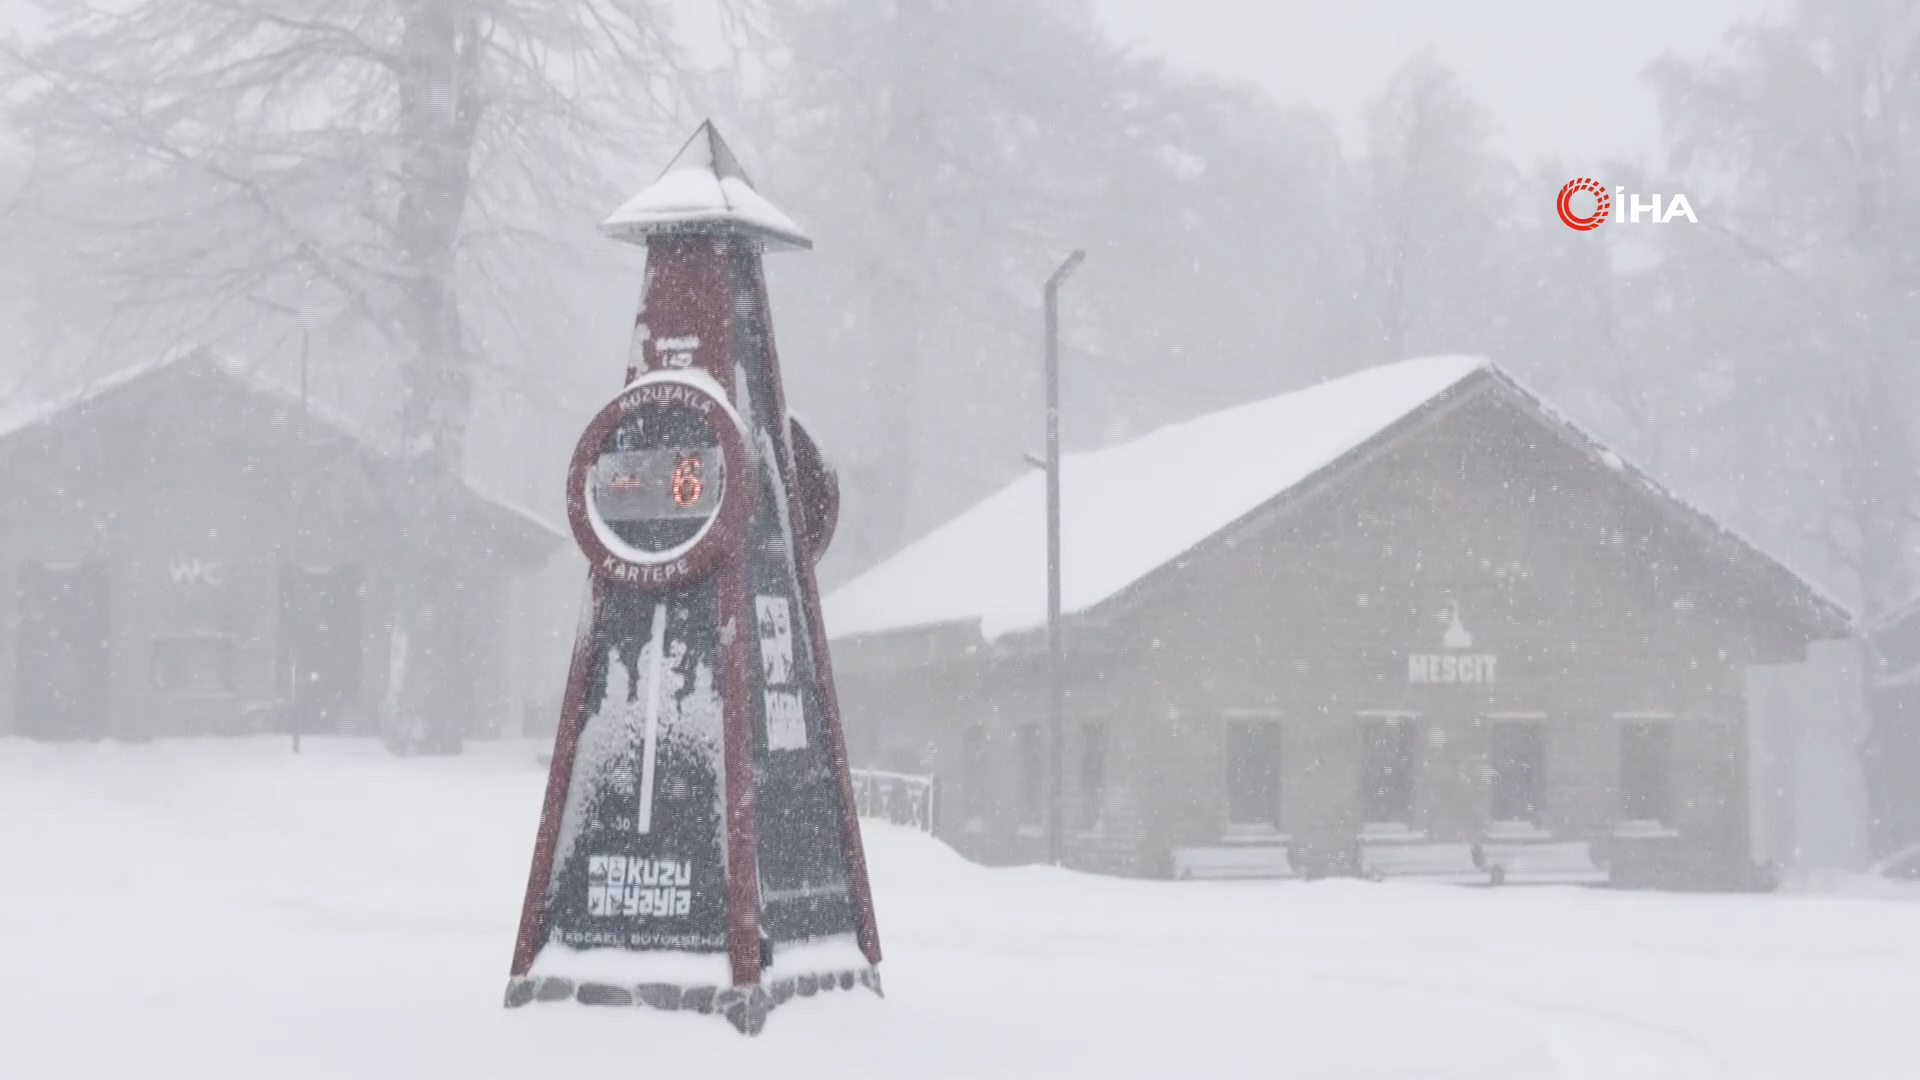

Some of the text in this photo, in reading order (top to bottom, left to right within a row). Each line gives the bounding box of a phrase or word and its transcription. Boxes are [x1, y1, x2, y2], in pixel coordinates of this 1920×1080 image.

[167, 556, 224, 586] WC
[602, 555, 689, 582] KARTEPE
[622, 886, 692, 916] yayla
